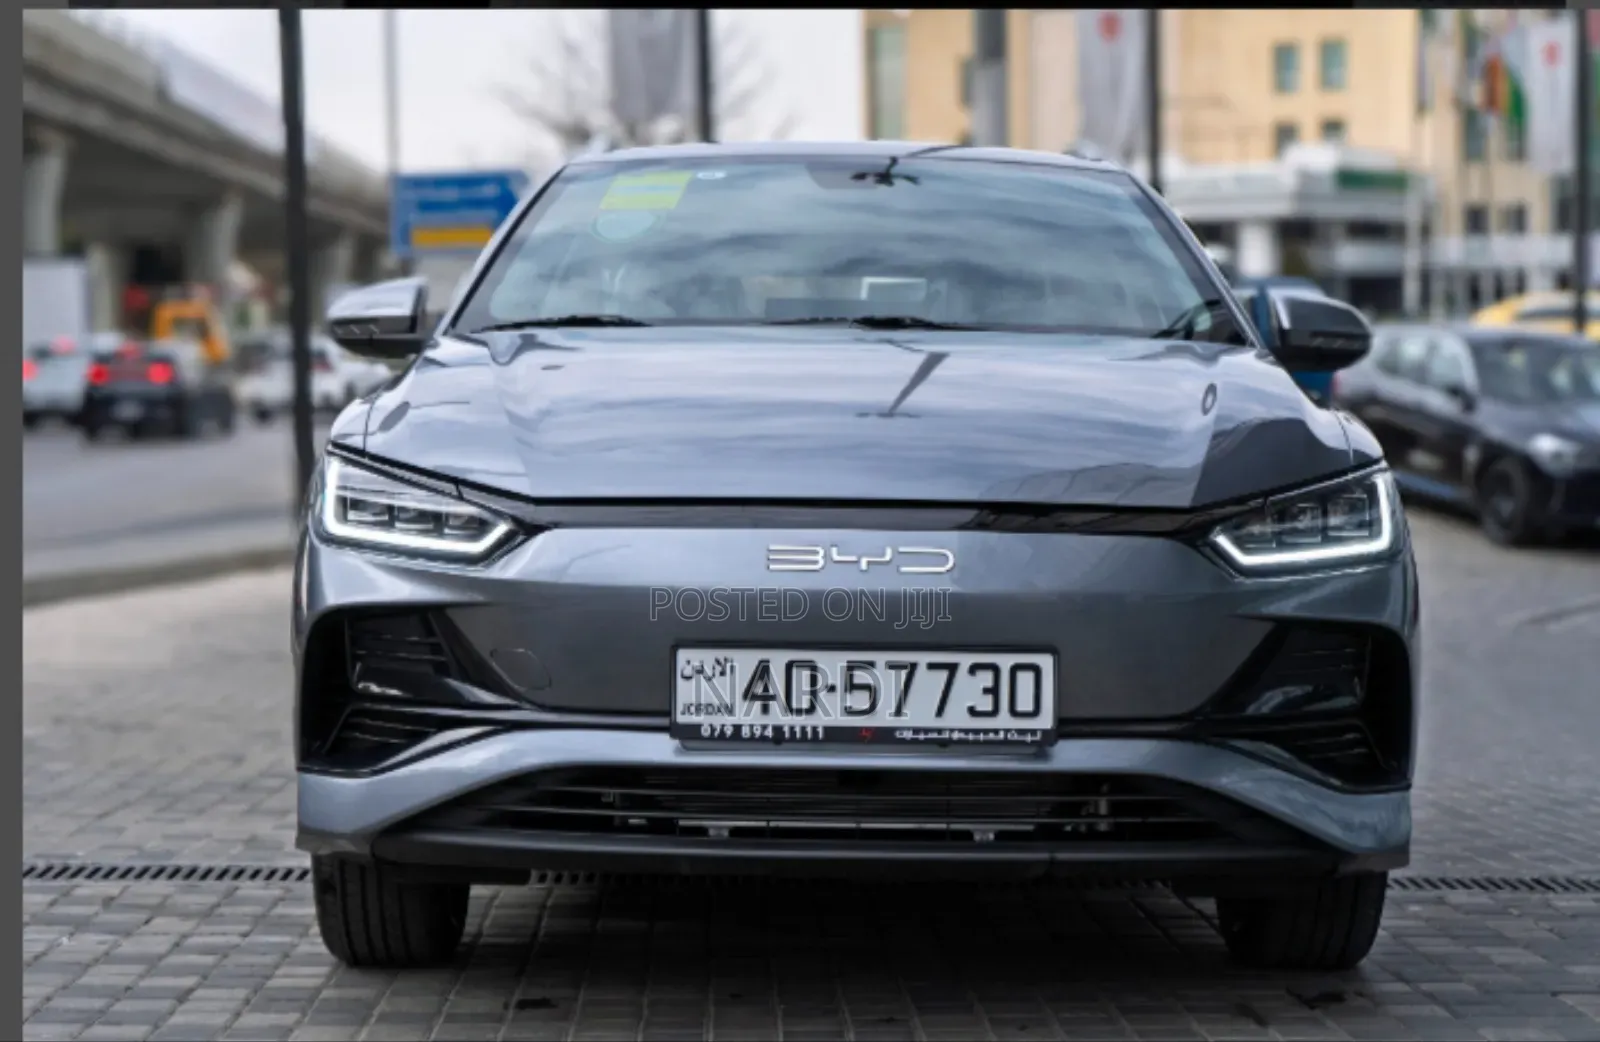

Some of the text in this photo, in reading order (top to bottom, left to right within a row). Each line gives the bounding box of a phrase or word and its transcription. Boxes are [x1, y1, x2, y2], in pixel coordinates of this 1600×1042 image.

[767, 544, 955, 573] BYD
[680, 702, 735, 717] JORDAN
[700, 724, 826, 740] 079 894 1111
